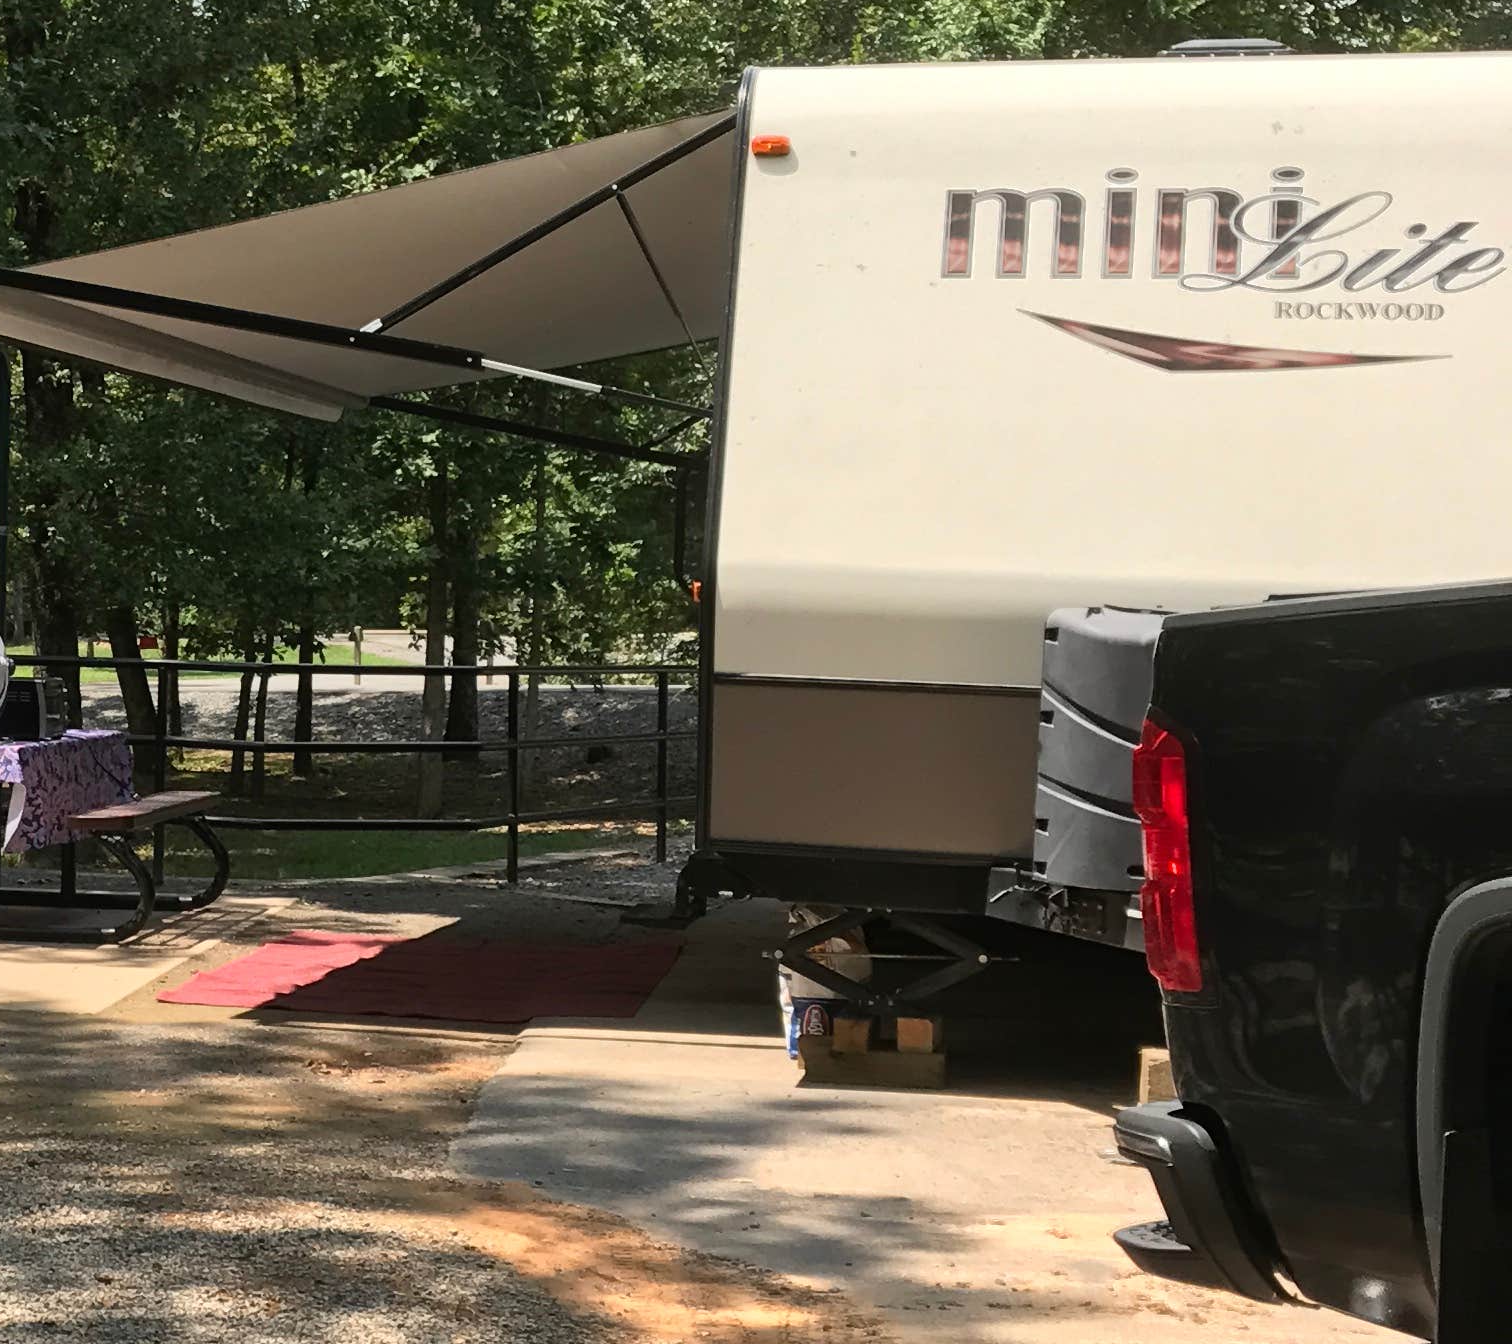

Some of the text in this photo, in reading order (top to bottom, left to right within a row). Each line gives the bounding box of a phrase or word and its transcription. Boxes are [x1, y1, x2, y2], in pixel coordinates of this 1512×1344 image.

[940, 166, 1506, 294] mini Lite
[1273, 300, 1445, 321] ROCKWOOD
